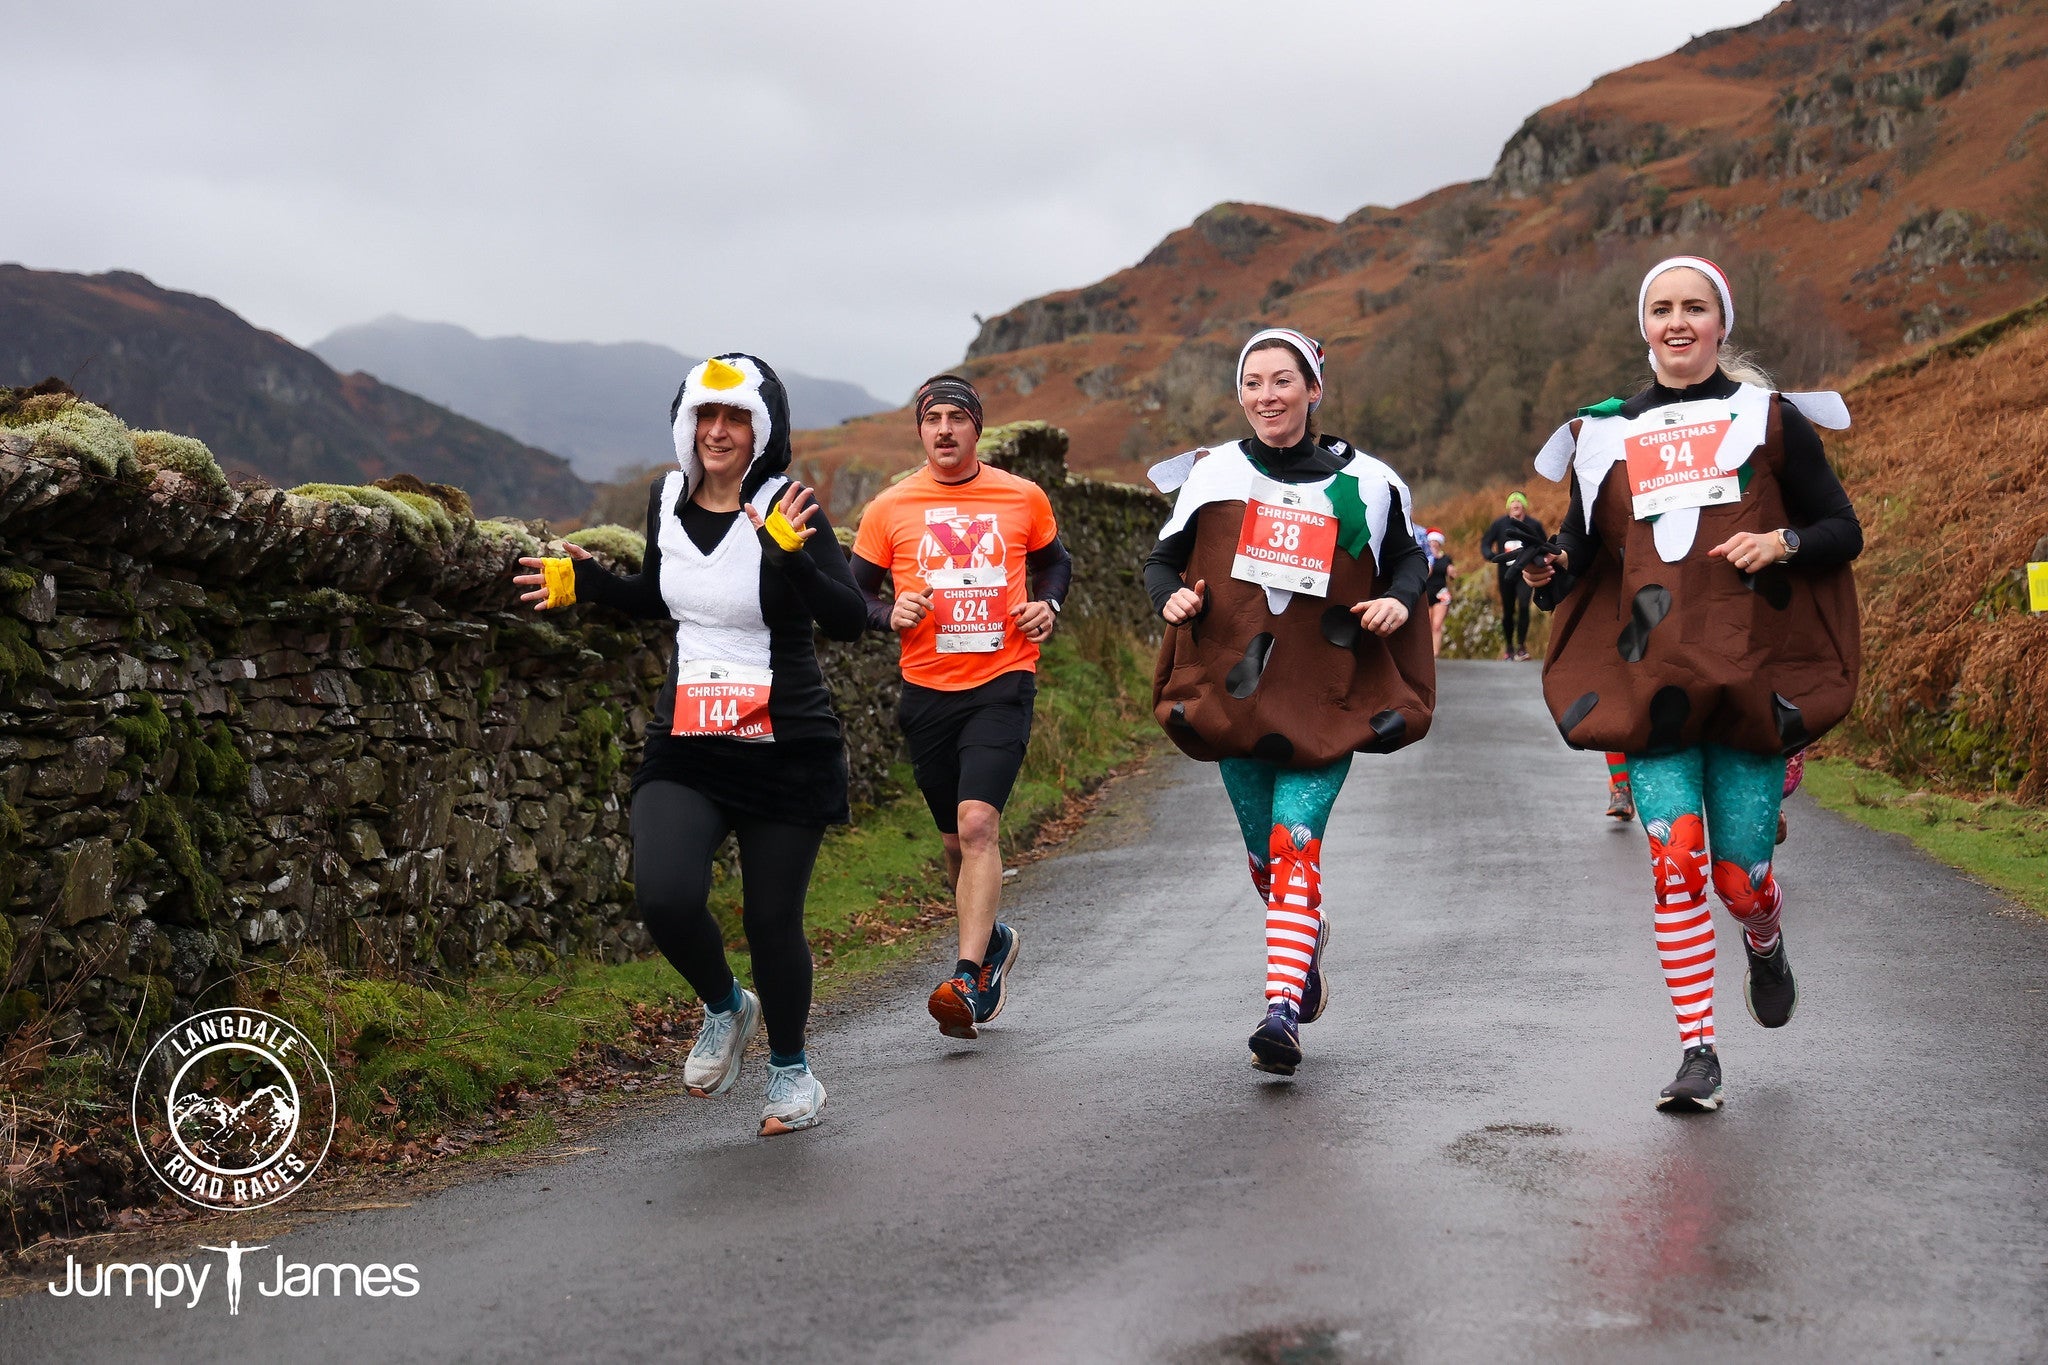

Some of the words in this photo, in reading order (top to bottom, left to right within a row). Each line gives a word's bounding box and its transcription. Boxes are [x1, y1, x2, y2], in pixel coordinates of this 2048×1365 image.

[1639, 424, 1717, 447] CHRISTMAS
[1659, 441, 1694, 471] 94
[1638, 469, 1700, 492] PUDDING
[1256, 505, 1325, 527] CHRISTMAS
[1268, 521, 1301, 551] 38
[1245, 545, 1299, 565] PUDDING
[1301, 557, 1324, 570] 10K
[943, 588, 999, 599] CHRISTMAS
[952, 599, 989, 622] 624
[941, 623, 986, 633] PUDDING
[987, 621, 1004, 631] 10K
[687, 686, 755, 697] CHRISTMAS
[699, 699, 740, 728] 144
[739, 723, 764, 737] 10K
